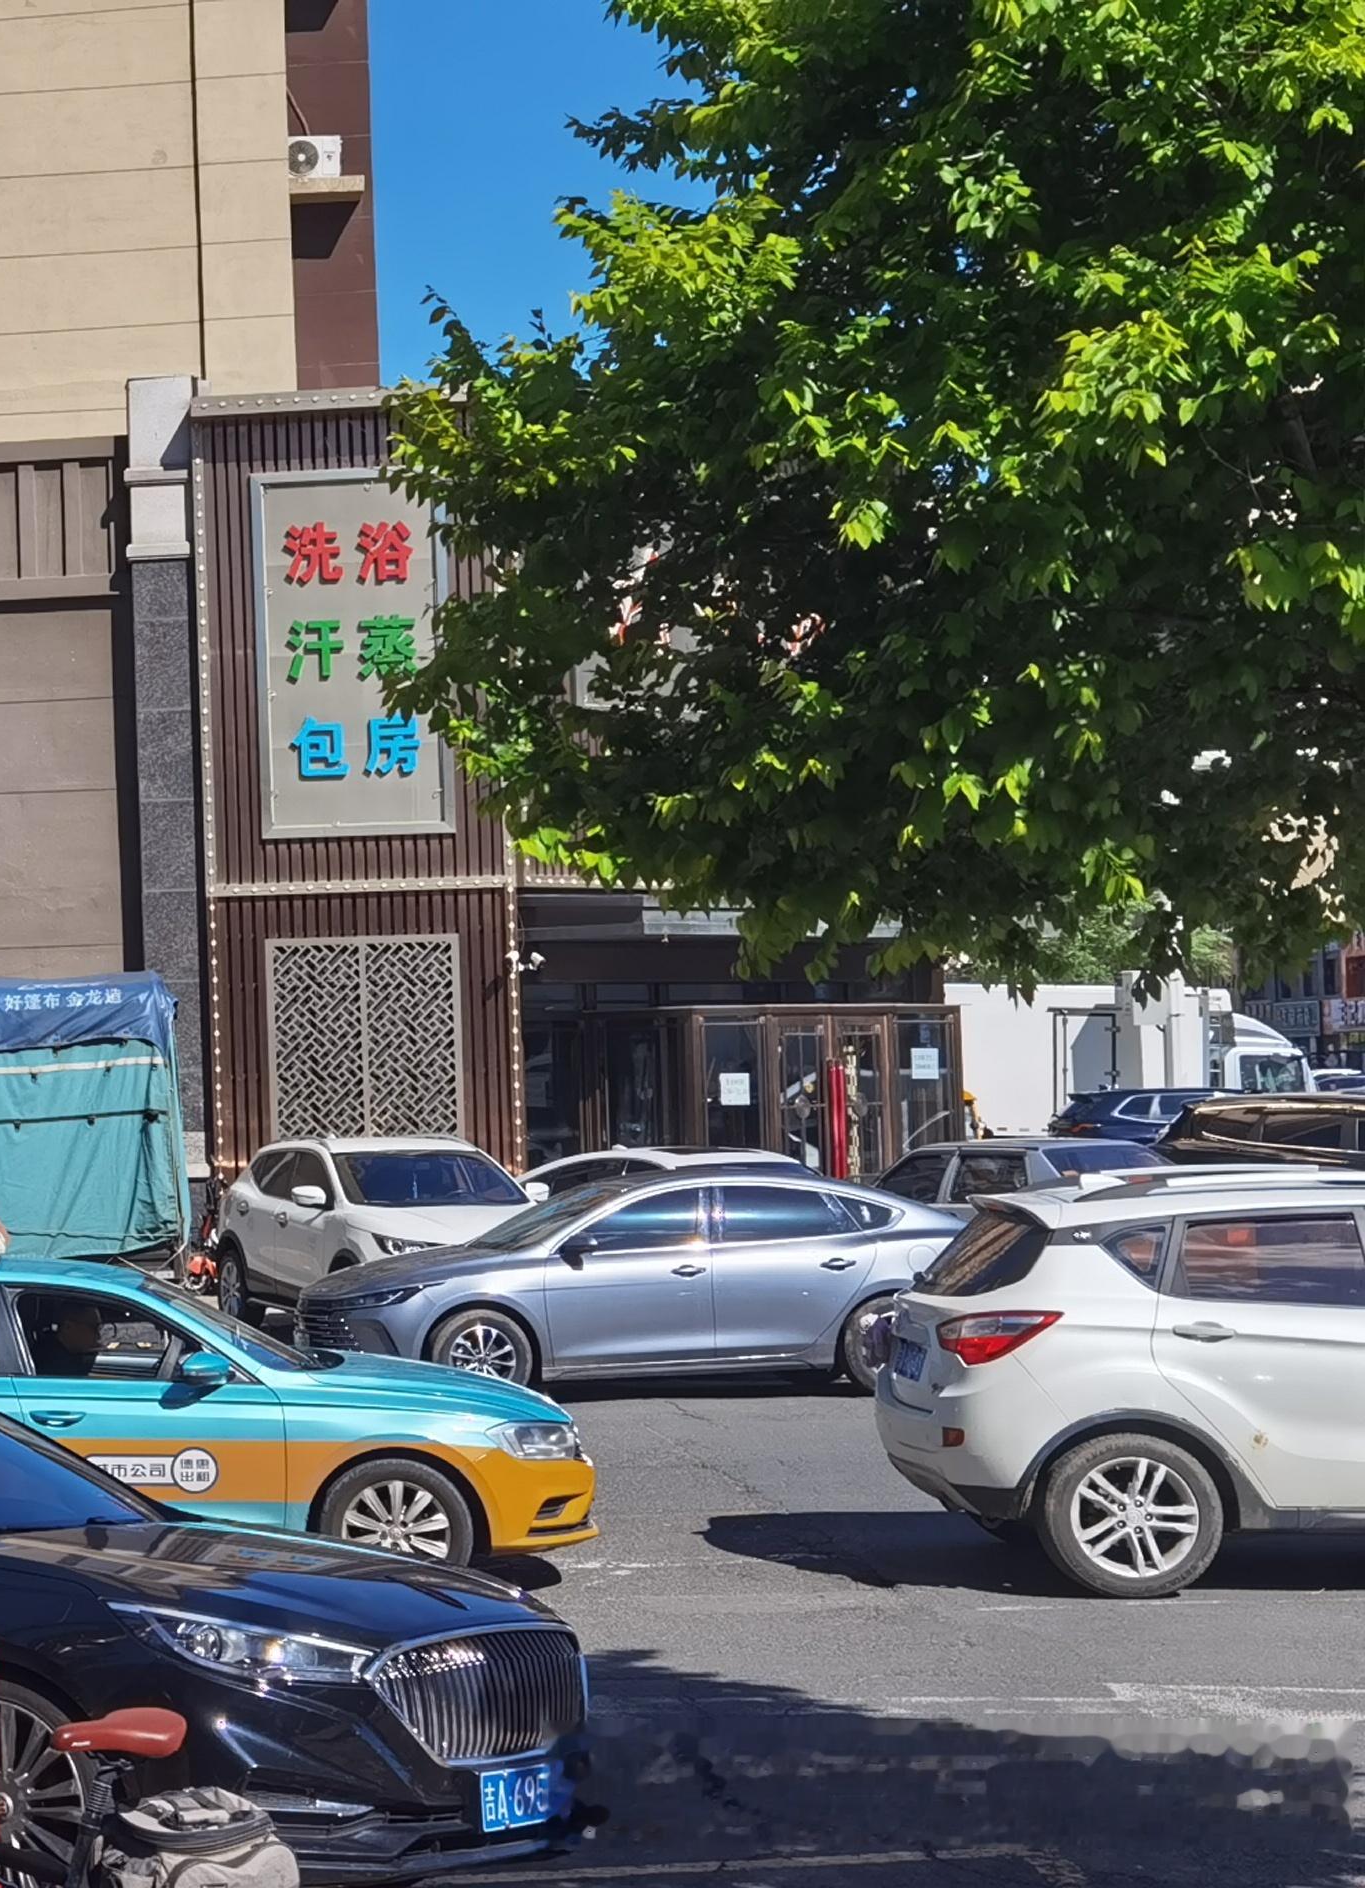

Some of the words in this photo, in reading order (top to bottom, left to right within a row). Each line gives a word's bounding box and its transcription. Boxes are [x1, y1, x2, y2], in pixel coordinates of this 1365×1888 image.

[283, 520, 413, 585] 洗浴
[286, 614, 419, 683] 汗蒸
[289, 714, 421, 779] 包房
[180, 1458, 210, 1469] 德惠
[180, 1471, 210, 1482] 出租
